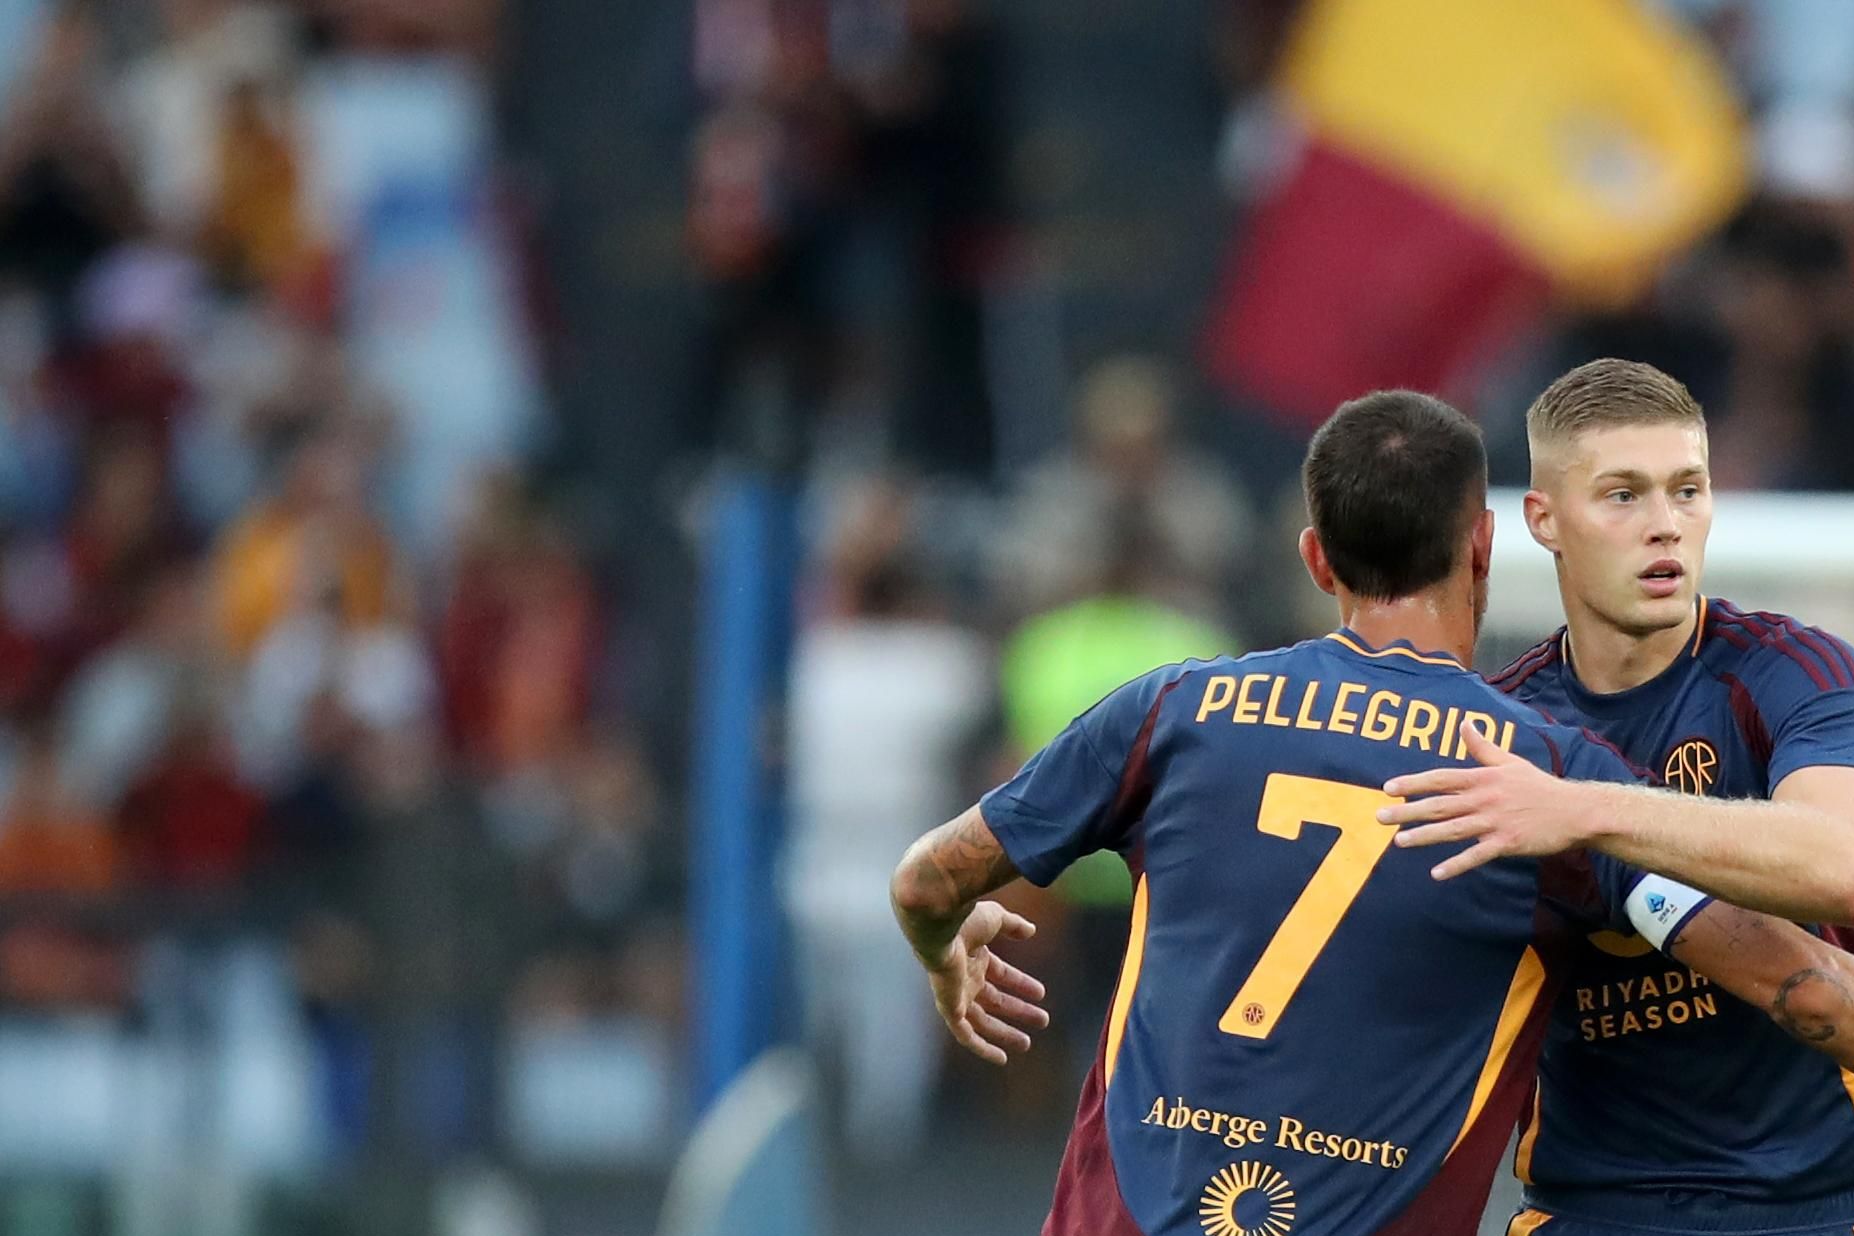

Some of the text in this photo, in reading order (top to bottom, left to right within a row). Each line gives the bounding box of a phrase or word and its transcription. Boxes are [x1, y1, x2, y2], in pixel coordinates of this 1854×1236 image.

[1195, 673, 1515, 760] PELLEGRINI
[1219, 773, 1405, 1039] 7
[1580, 993, 1717, 1041] SEASON
[1275, 1116, 1408, 1168] Resorts
